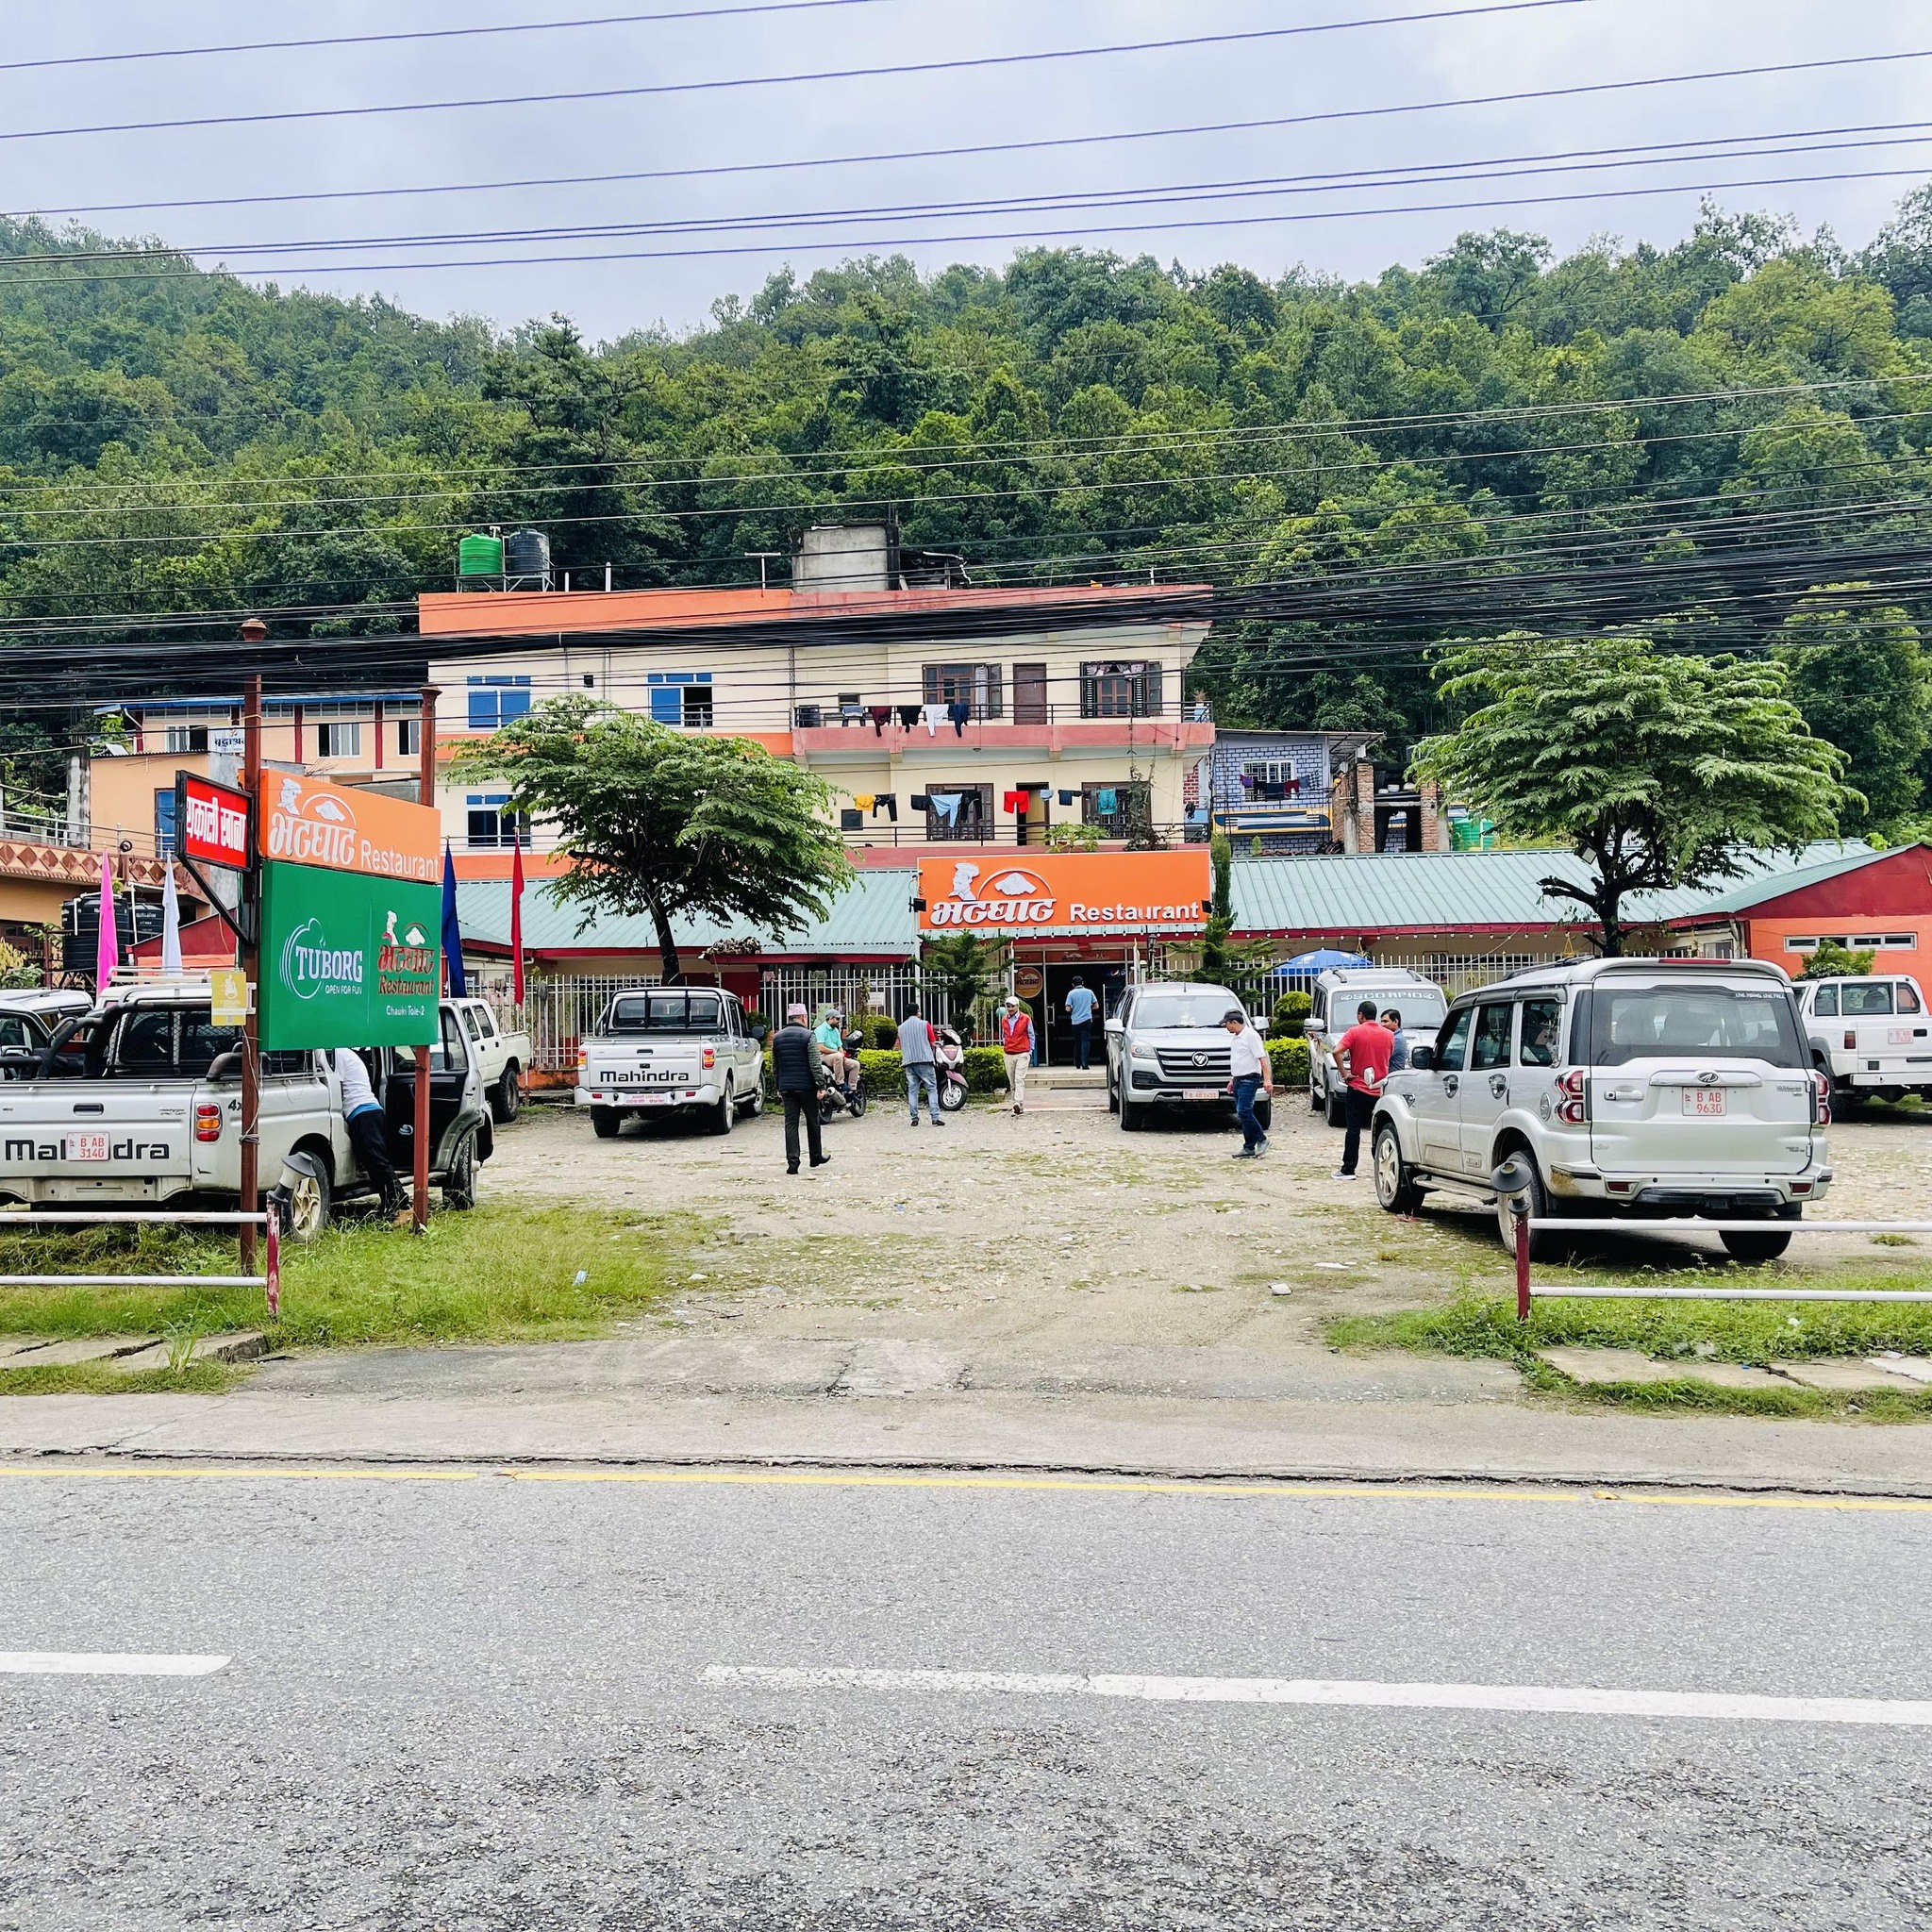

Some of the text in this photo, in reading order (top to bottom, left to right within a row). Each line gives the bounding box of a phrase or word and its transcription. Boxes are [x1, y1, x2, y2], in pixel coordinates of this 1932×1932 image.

[360, 839, 441, 880] Restaurant
[1070, 901, 1200, 923] Restaurant
[295, 945, 363, 983] TUBORG
[325, 984, 362, 995] OPEN FOR FUN
[378, 974, 435, 996] Restaurant
[600, 1071, 690, 1083] Mahindra
[1696, 1092, 1722, 1103] B AB
[1696, 1103, 1723, 1114] 9630
[80, 1137, 105, 1147] B AB
[5, 1138, 170, 1161] Madra
[79, 1148, 105, 1158] 3140
